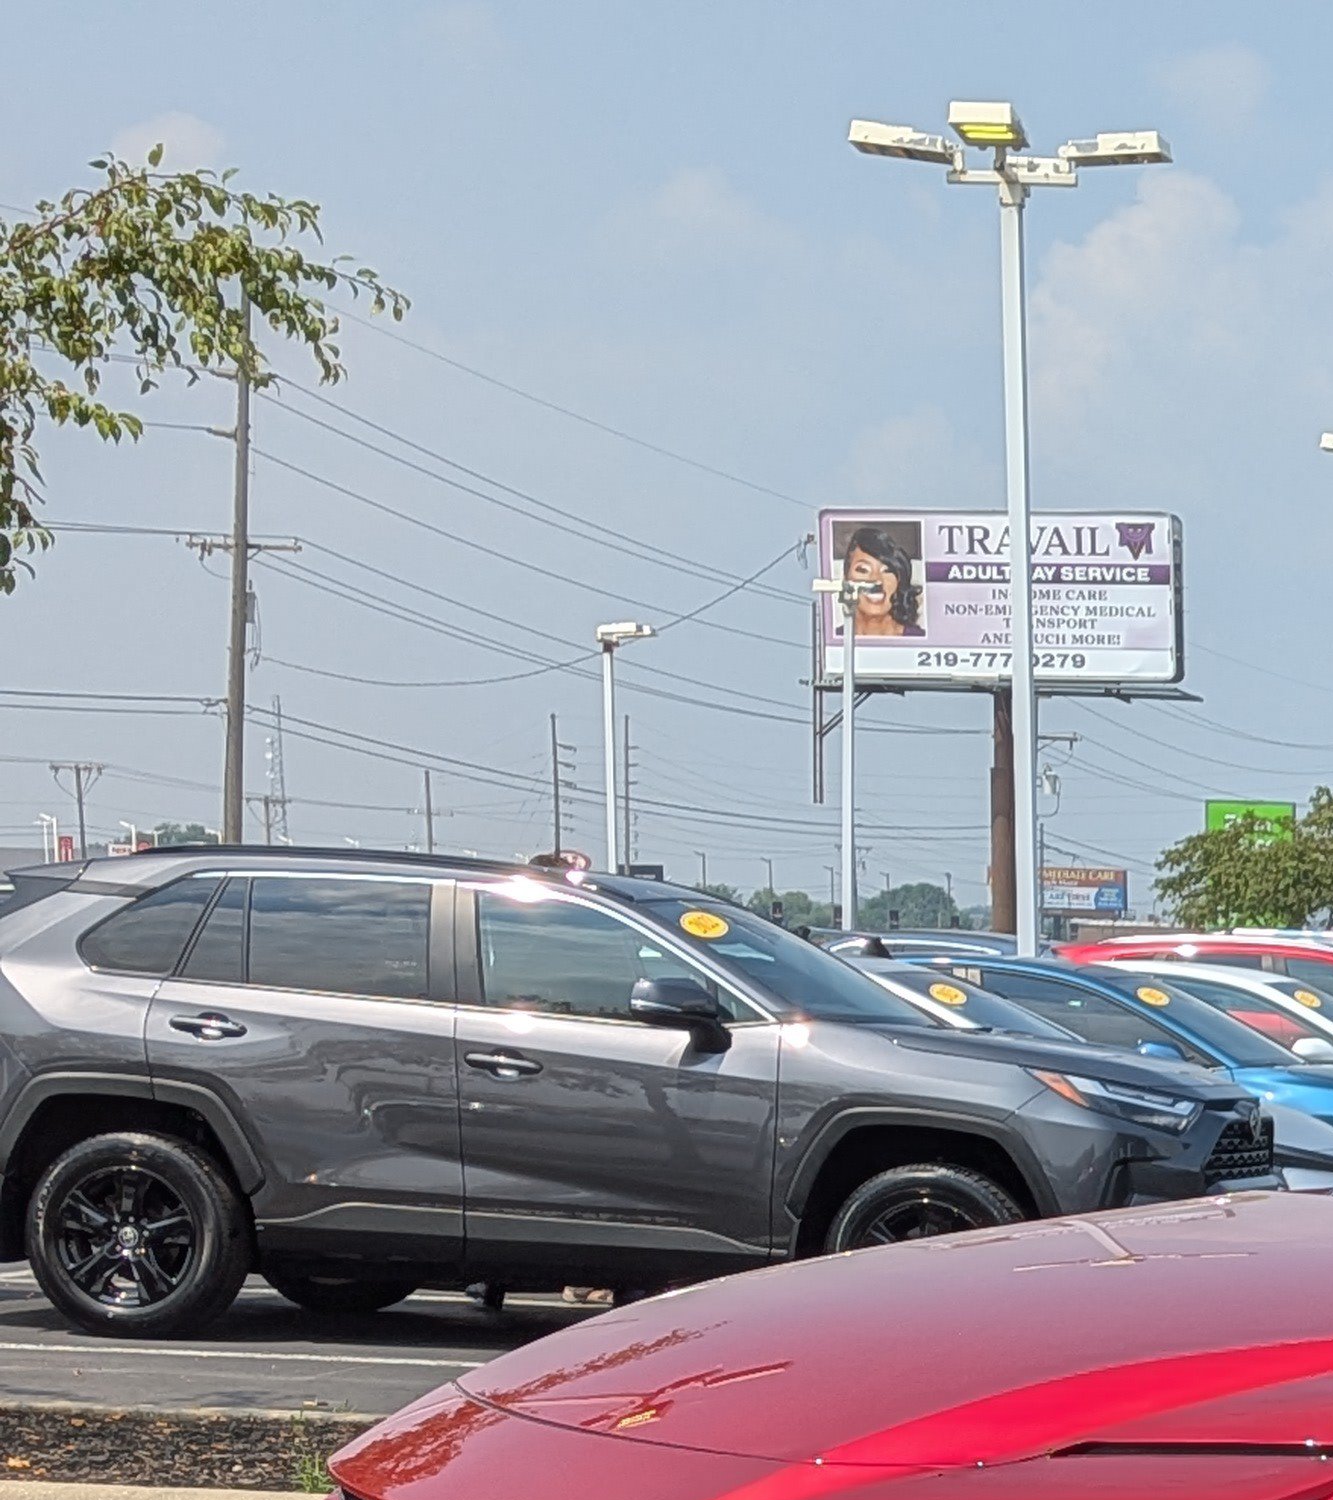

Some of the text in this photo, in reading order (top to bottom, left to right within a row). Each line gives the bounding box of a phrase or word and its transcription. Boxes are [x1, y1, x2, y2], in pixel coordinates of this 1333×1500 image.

[948, 565, 1150, 582] ADULT AY SERVICE
[1065, 590, 1107, 601] CARE
[944, 604, 1156, 617] NON-EMGENCY MEDICAL
[1002, 618, 1097, 629] TNSPORT
[1032, 634, 1066, 645] UCH
[1071, 634, 1121, 646] MORE!
[917, 651, 1086, 669] 219-7770279
